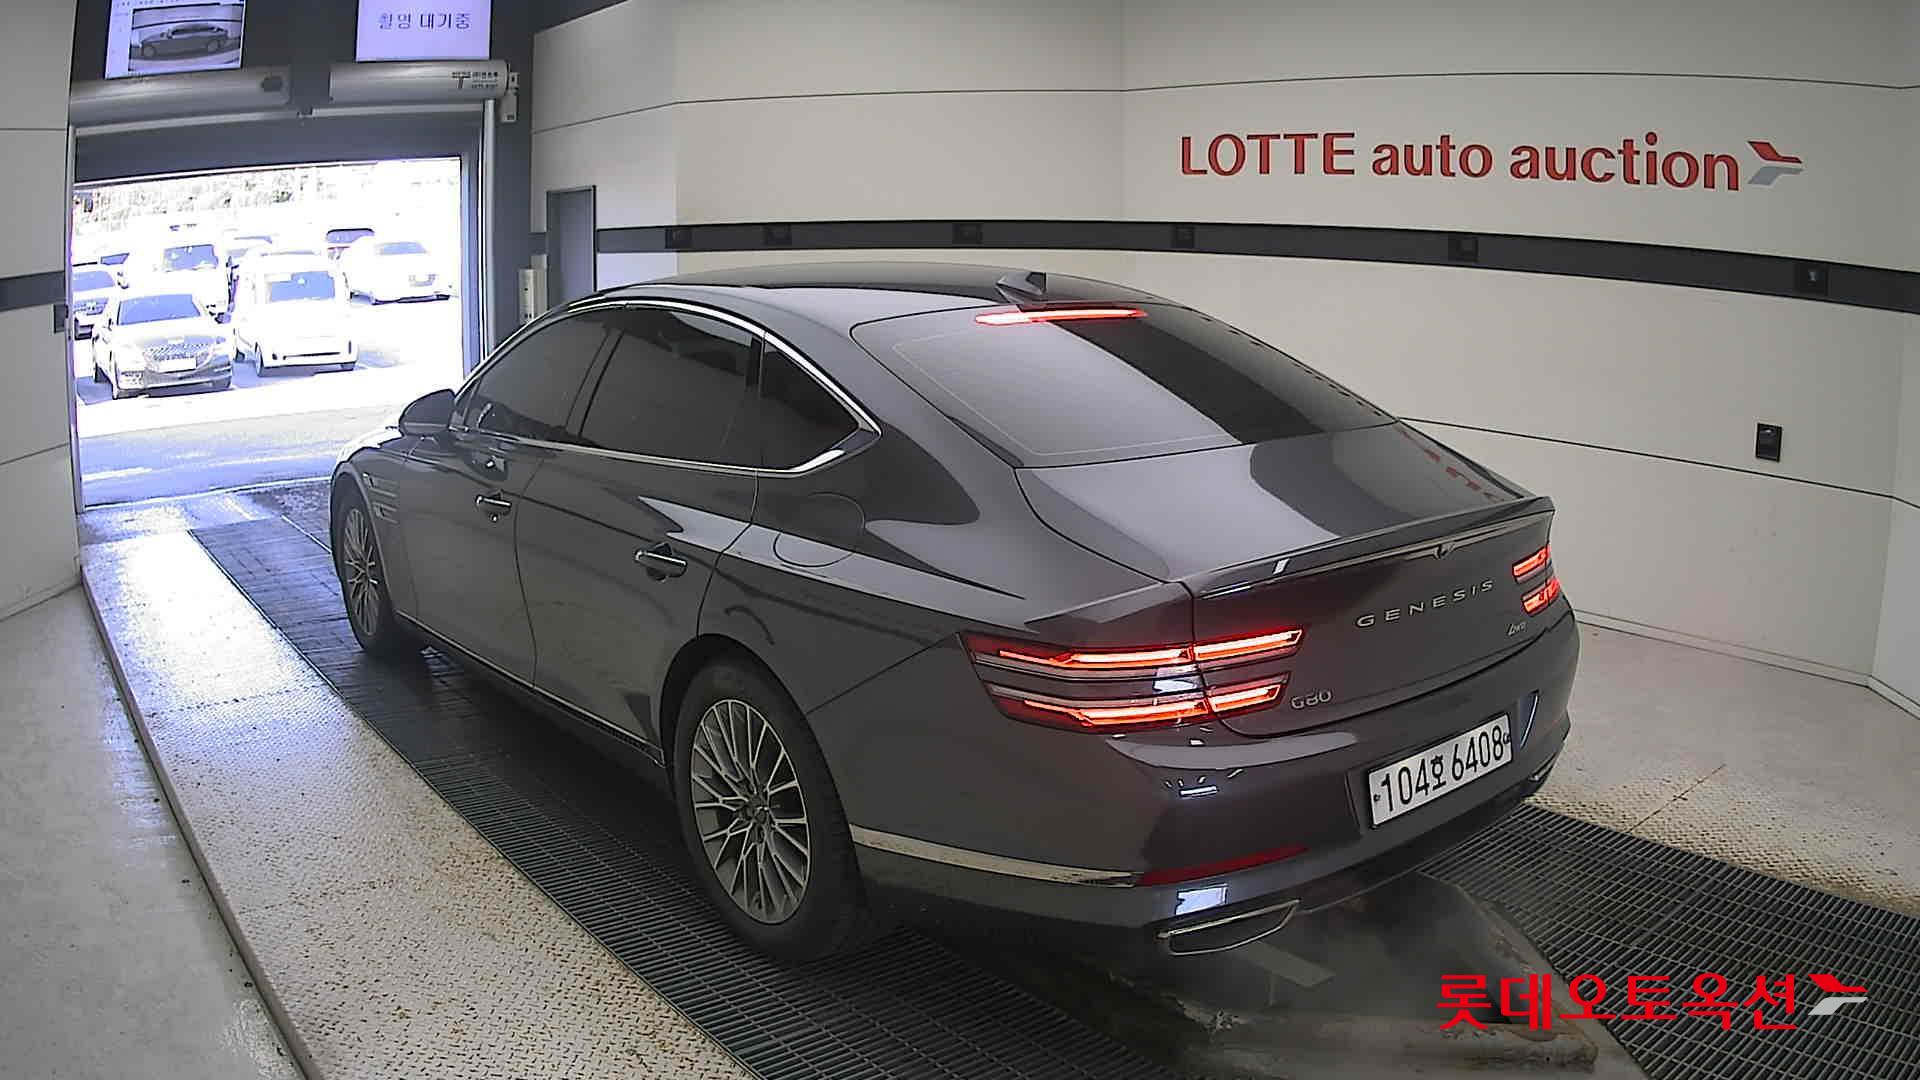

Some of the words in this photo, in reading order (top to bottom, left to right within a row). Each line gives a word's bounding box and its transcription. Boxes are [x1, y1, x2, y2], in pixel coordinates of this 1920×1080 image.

[419, 13, 471, 29] 대기중
[1180, 132, 1355, 176] LOTTE
[1371, 134, 1493, 178] auto
[1509, 131, 1739, 191] auction
[1356, 579, 1493, 628] GENESIS
[1291, 689, 1332, 709] G80
